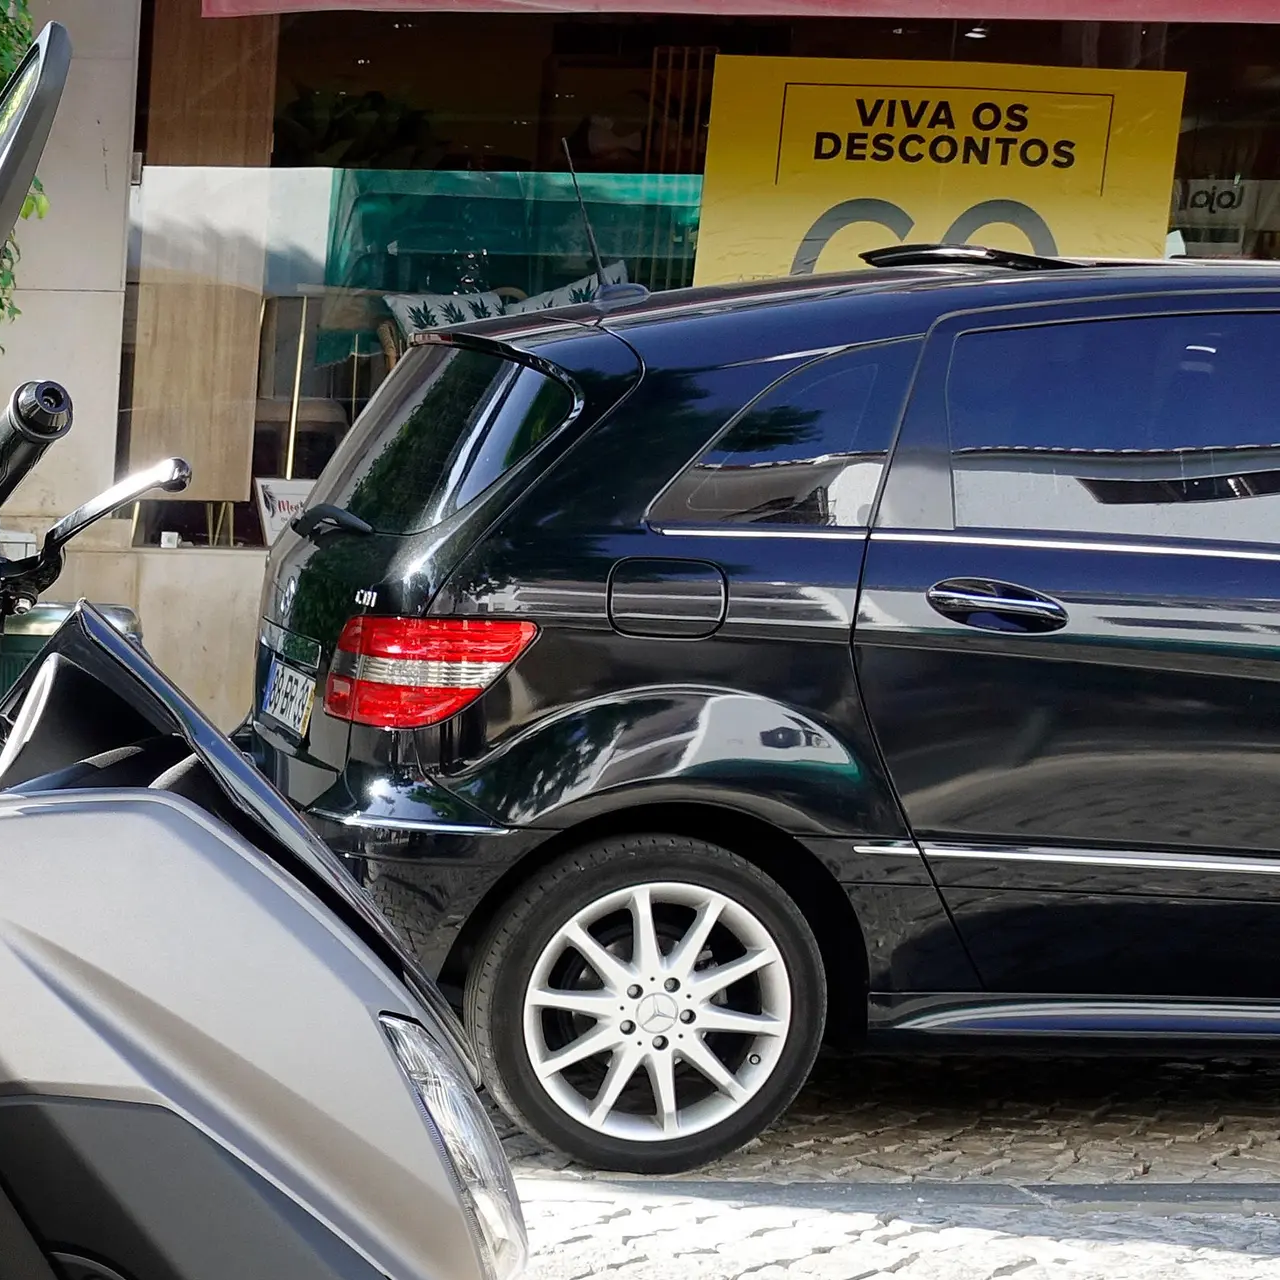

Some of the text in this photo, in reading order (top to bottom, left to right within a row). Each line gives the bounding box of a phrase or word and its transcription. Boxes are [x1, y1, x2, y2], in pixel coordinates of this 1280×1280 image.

[855, 98, 1029, 132] VIVA OS
[813, 131, 1076, 169] DESCONTOS
